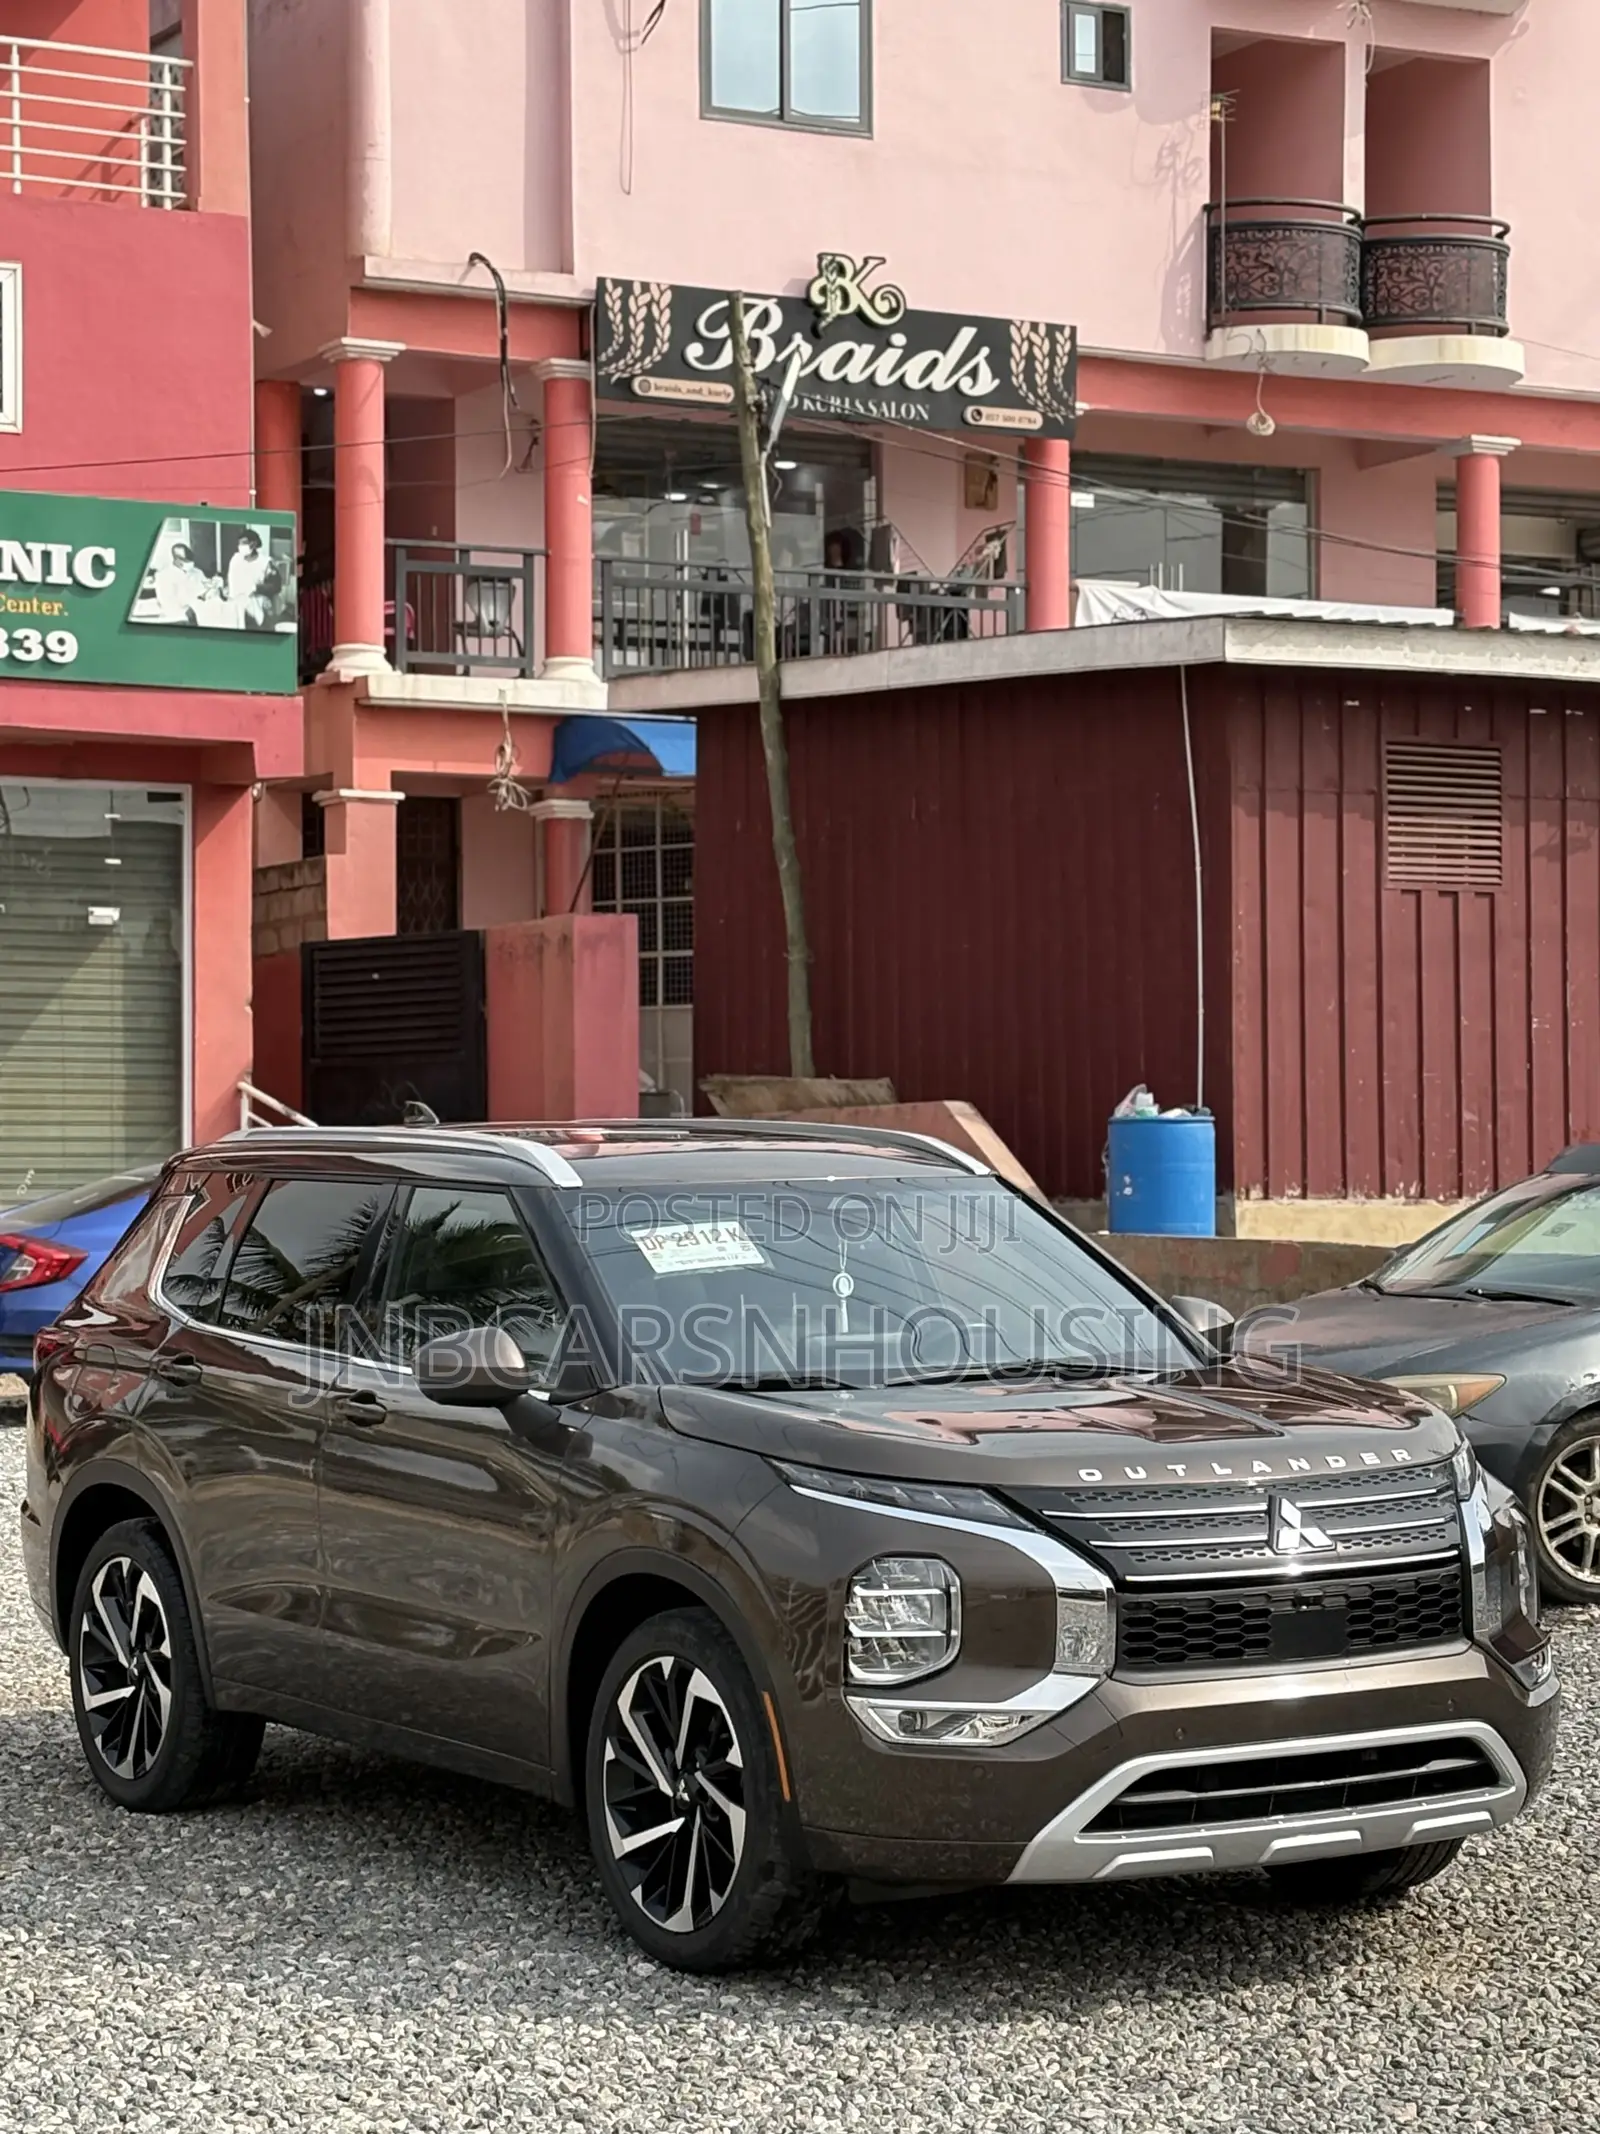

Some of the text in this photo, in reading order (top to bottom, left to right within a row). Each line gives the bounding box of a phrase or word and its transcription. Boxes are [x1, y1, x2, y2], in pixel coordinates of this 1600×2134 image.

[807, 252, 907, 328] BK
[683, 297, 1000, 397] Braids
[867, 399, 930, 421] SALON
[0, 539, 116, 589] NIC
[671, 1228, 729, 1248] 2912
[1078, 1448, 1412, 1482] OUTLANDER
